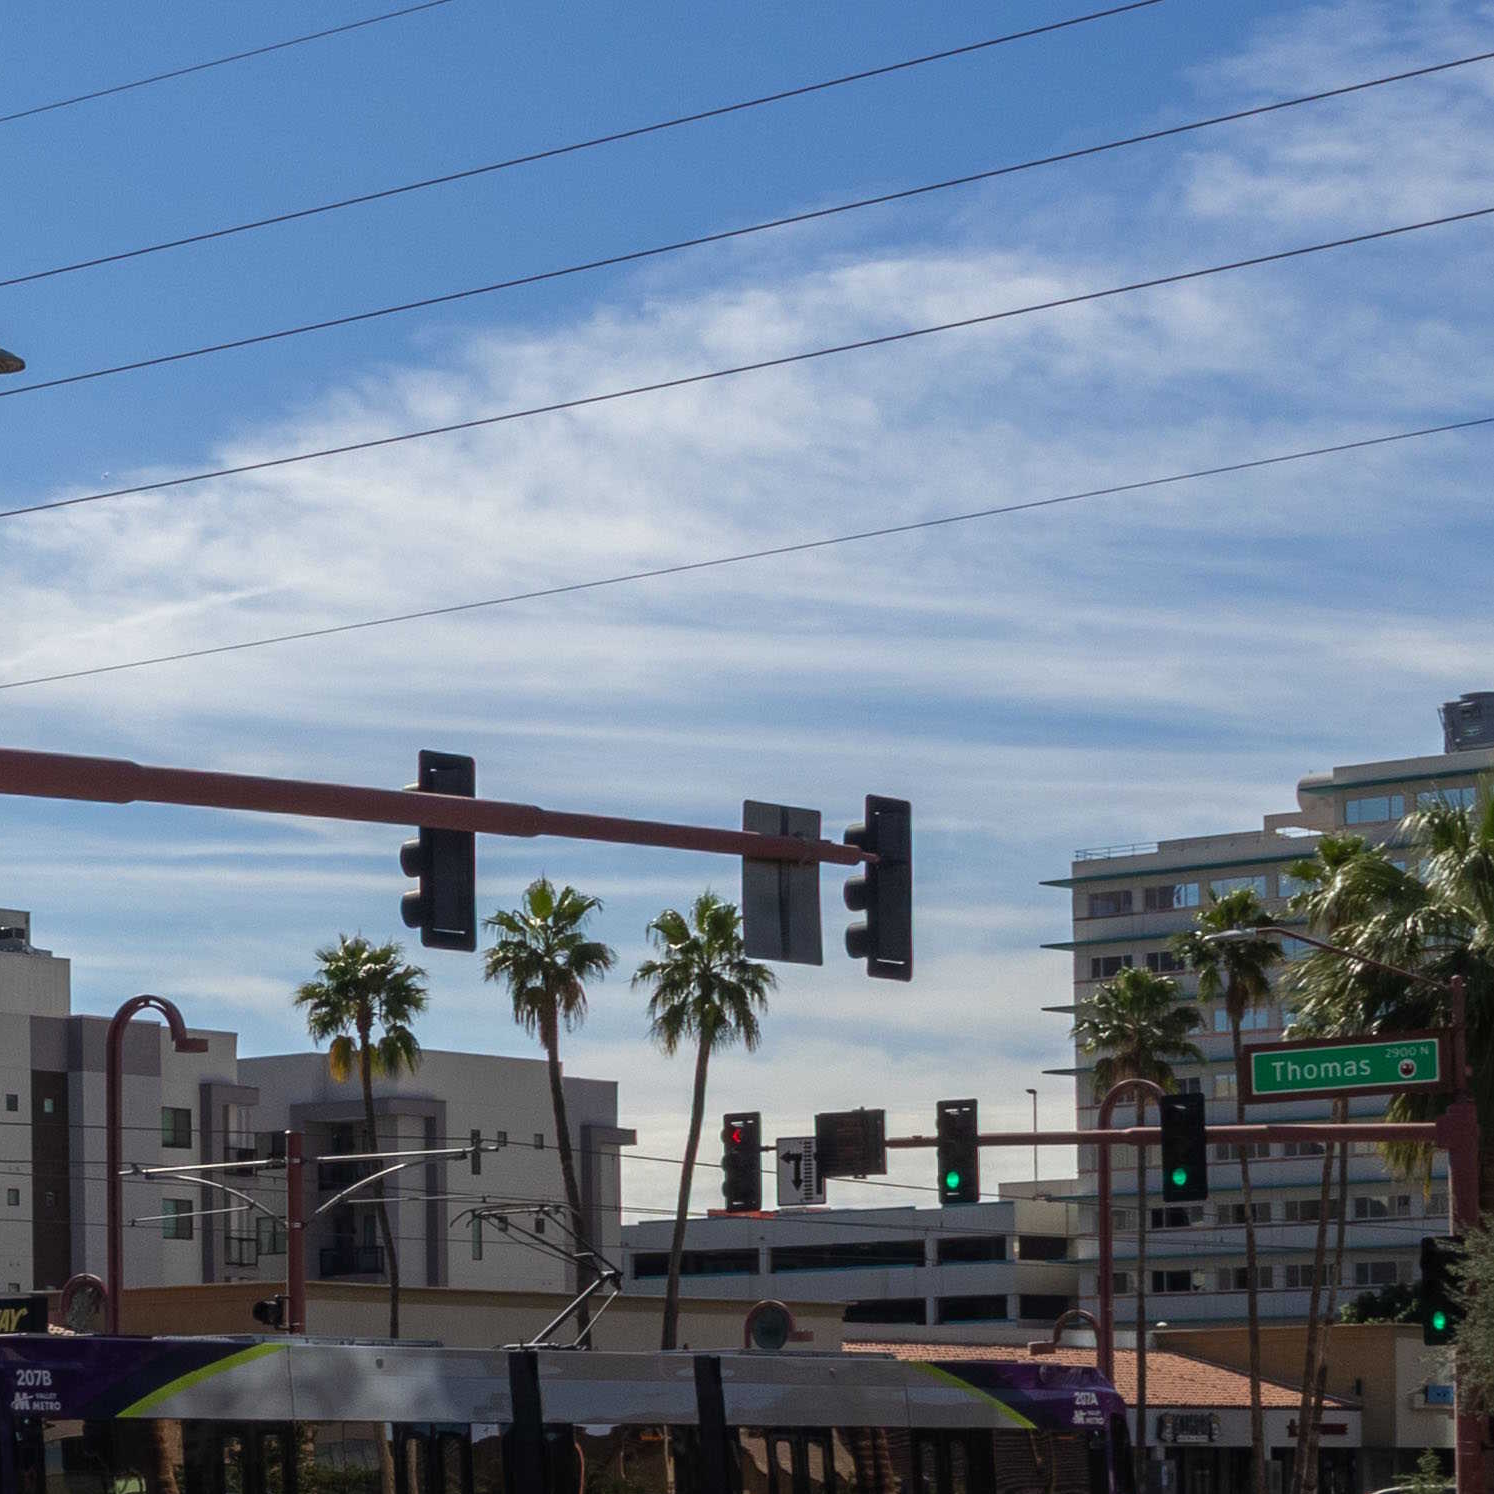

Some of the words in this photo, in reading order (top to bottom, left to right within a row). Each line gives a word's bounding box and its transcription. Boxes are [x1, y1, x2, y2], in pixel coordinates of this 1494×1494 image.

[1270, 1058, 1372, 1082] Thomas
[16, 1369, 52, 1386] 207B
[32, 1402, 62, 1411] METRO
